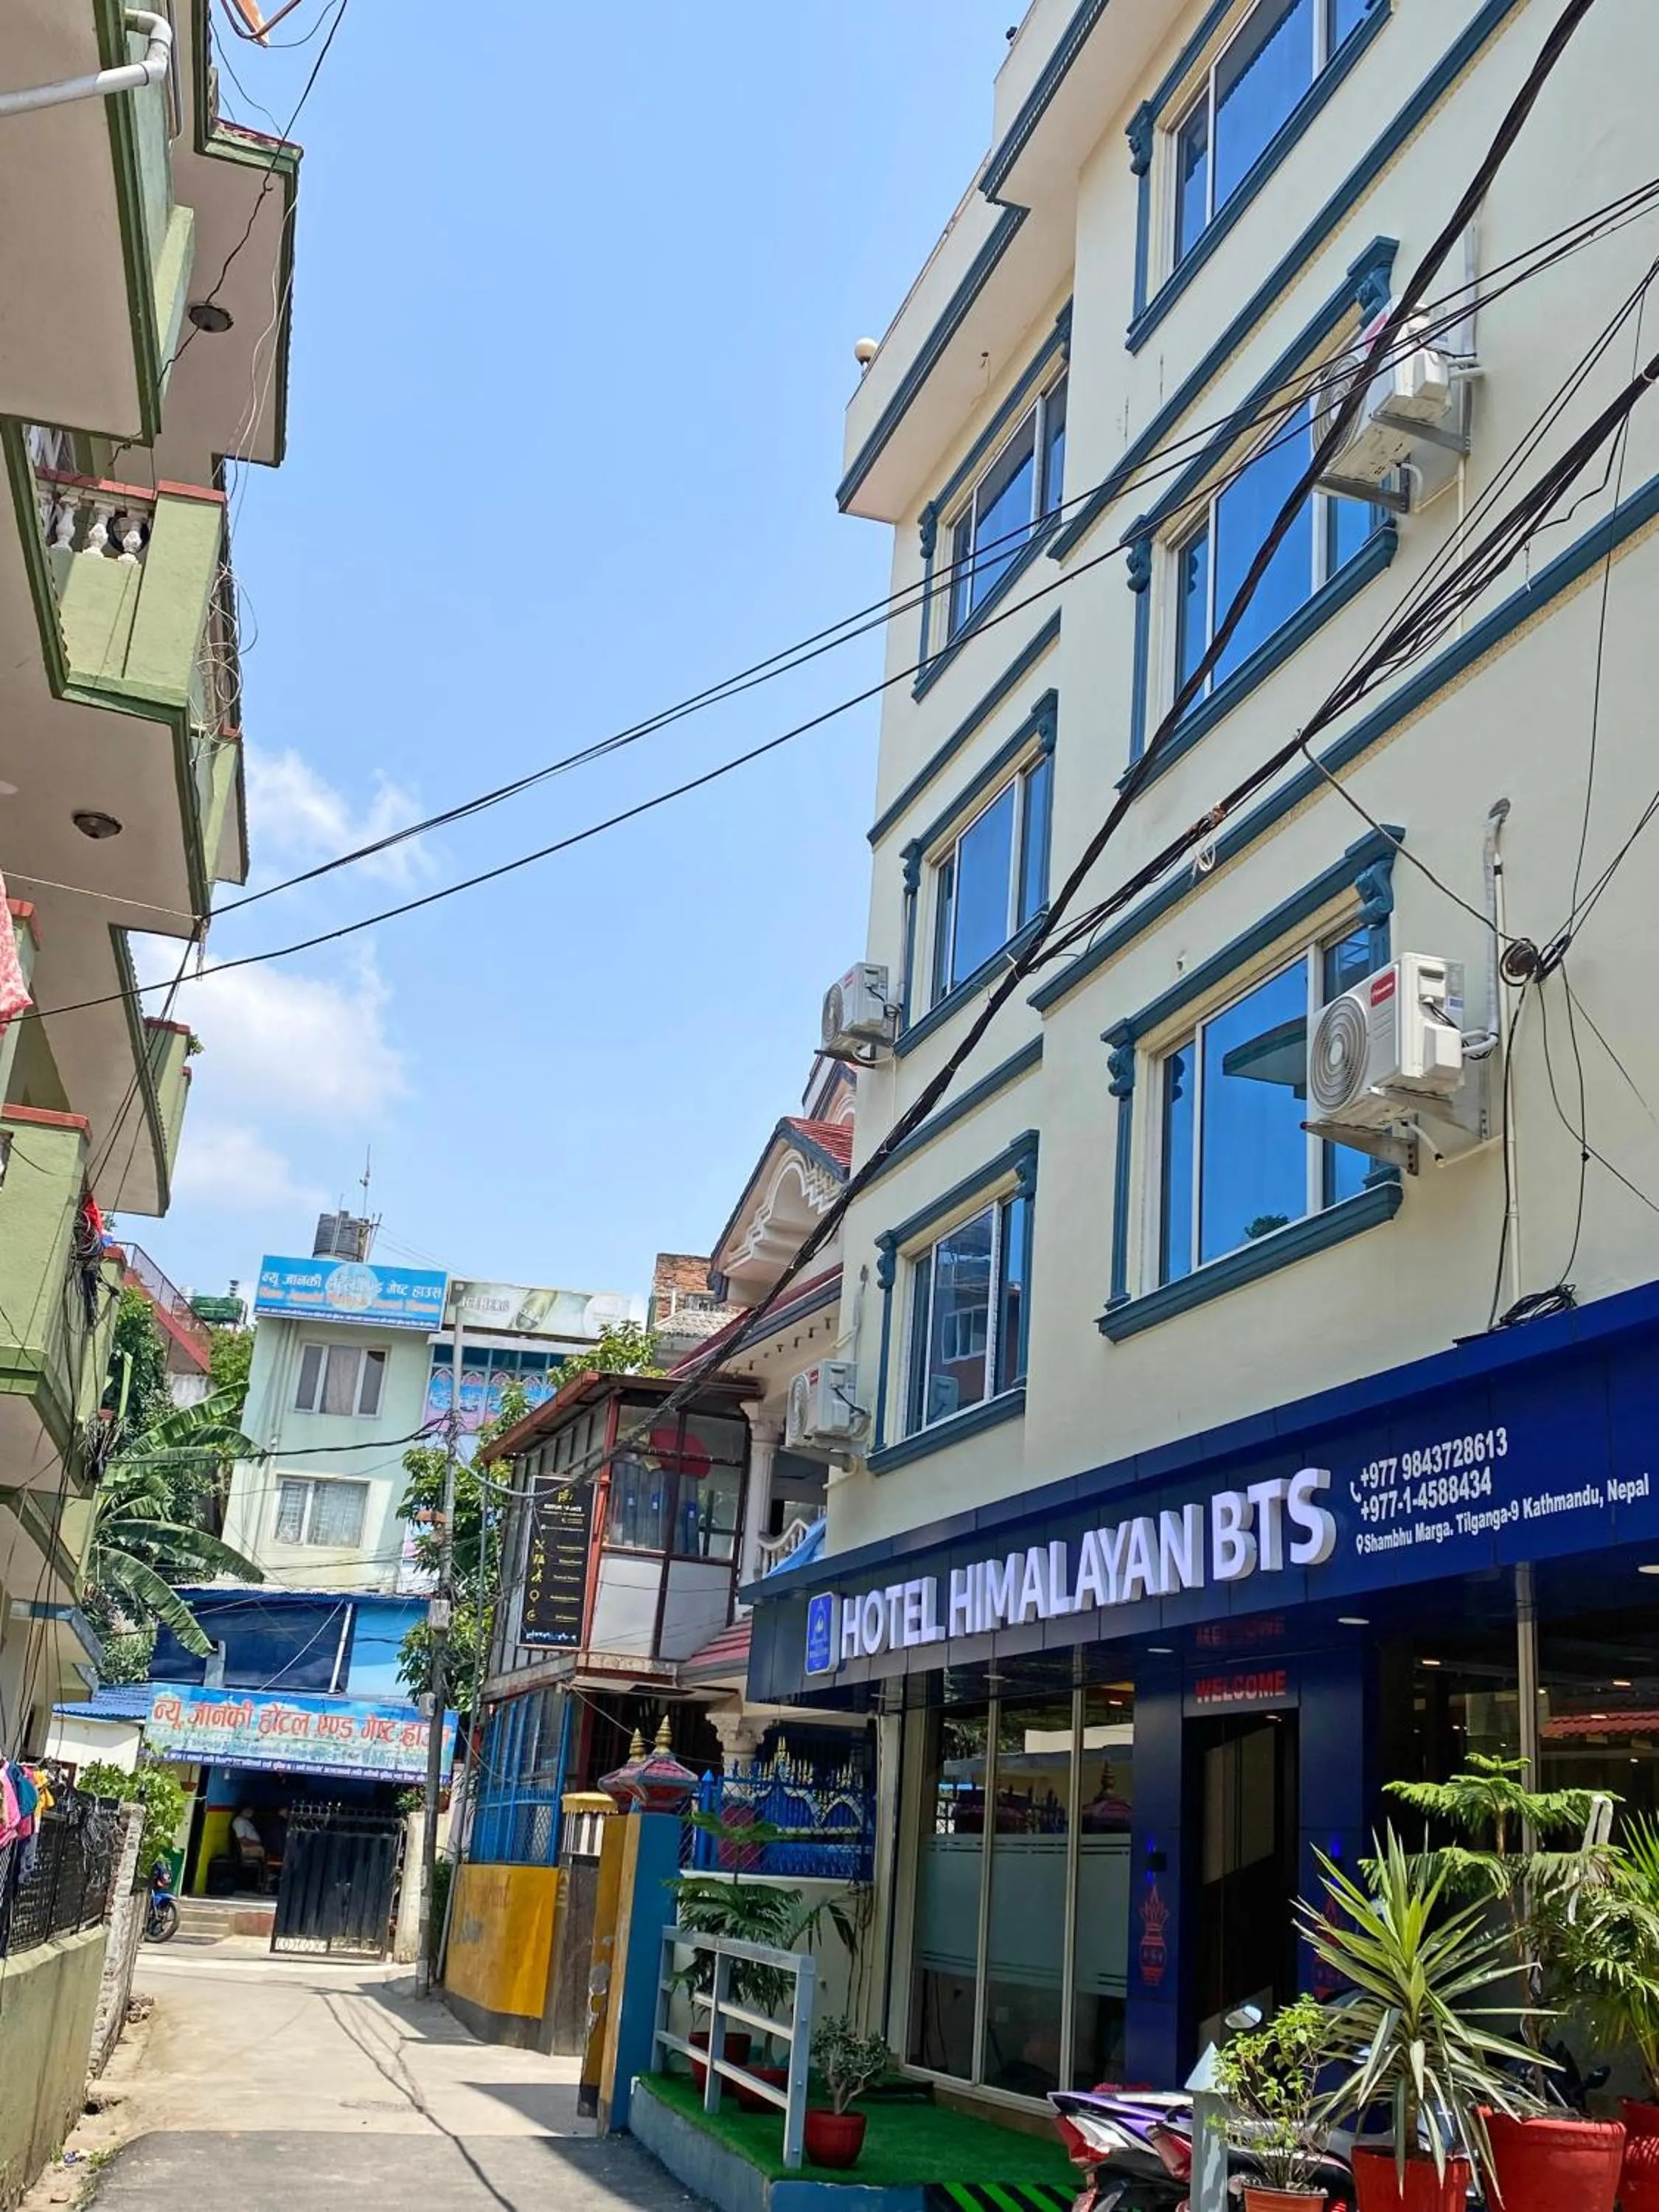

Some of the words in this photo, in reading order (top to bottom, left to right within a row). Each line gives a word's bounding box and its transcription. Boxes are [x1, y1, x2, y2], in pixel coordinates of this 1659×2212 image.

[283, 1273, 322, 1288] जानकी
[412, 1285, 441, 1299] हाउस
[1360, 1457, 1397, 1489] +977
[1402, 1427, 1508, 1481] 9843728613
[1360, 1466, 1492, 1522] +977-1-4588434
[1365, 1527, 1412, 1554] Shambhu
[1455, 1500, 1519, 1536] Tilganga-9
[1523, 1484, 1604, 1519] Kathmandu,
[1607, 1472, 1649, 1503] Nepal
[841, 1576, 945, 1659] HOTEL
[949, 1504, 1203, 1637] HIMALAYAN
[1212, 1468, 1336, 1580] BTS
[1195, 1669, 1287, 1704] WELCOME
[153, 1699, 184, 1730] न्यू
[187, 1699, 254, 1730] जानकी
[259, 1703, 311, 1737] होटल
